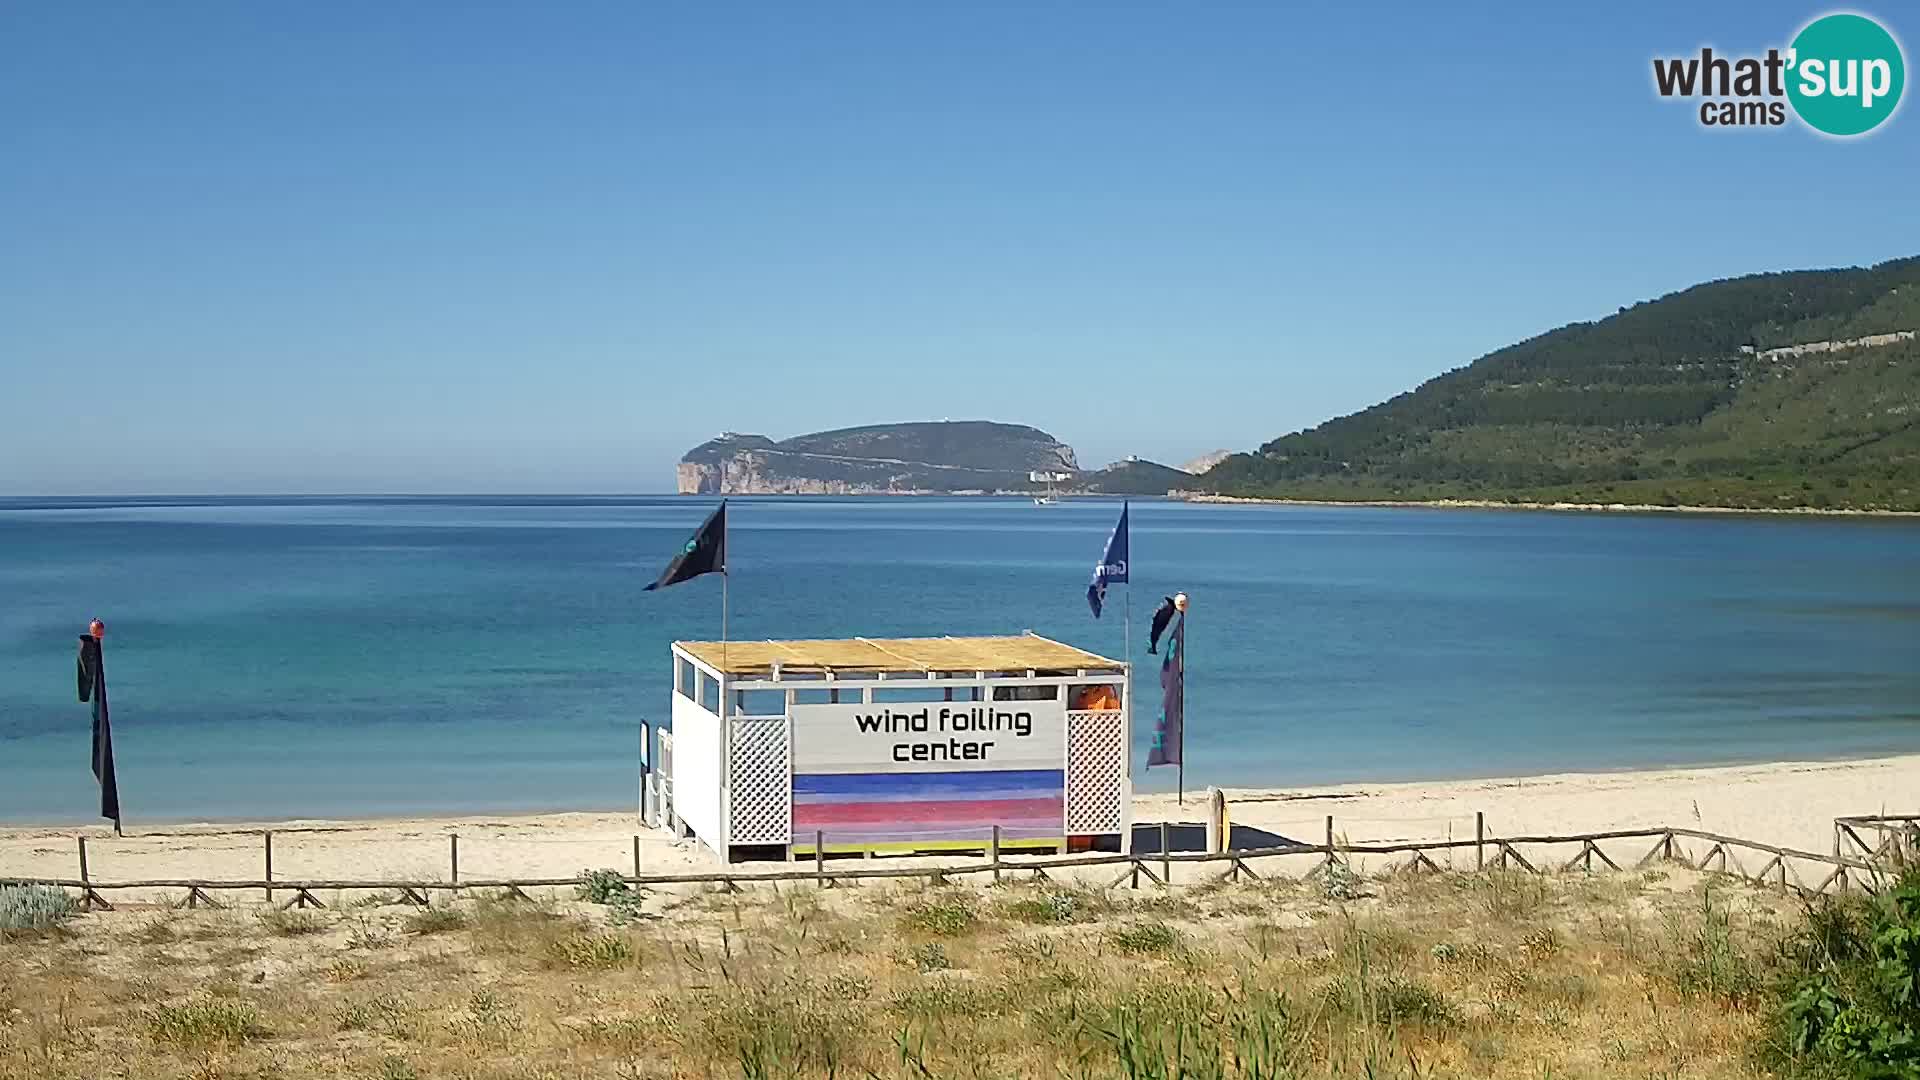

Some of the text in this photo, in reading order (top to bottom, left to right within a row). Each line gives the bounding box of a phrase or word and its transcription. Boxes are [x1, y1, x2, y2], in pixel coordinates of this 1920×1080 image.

[855, 707, 1032, 737] wind foiling
[893, 738, 994, 762] center
